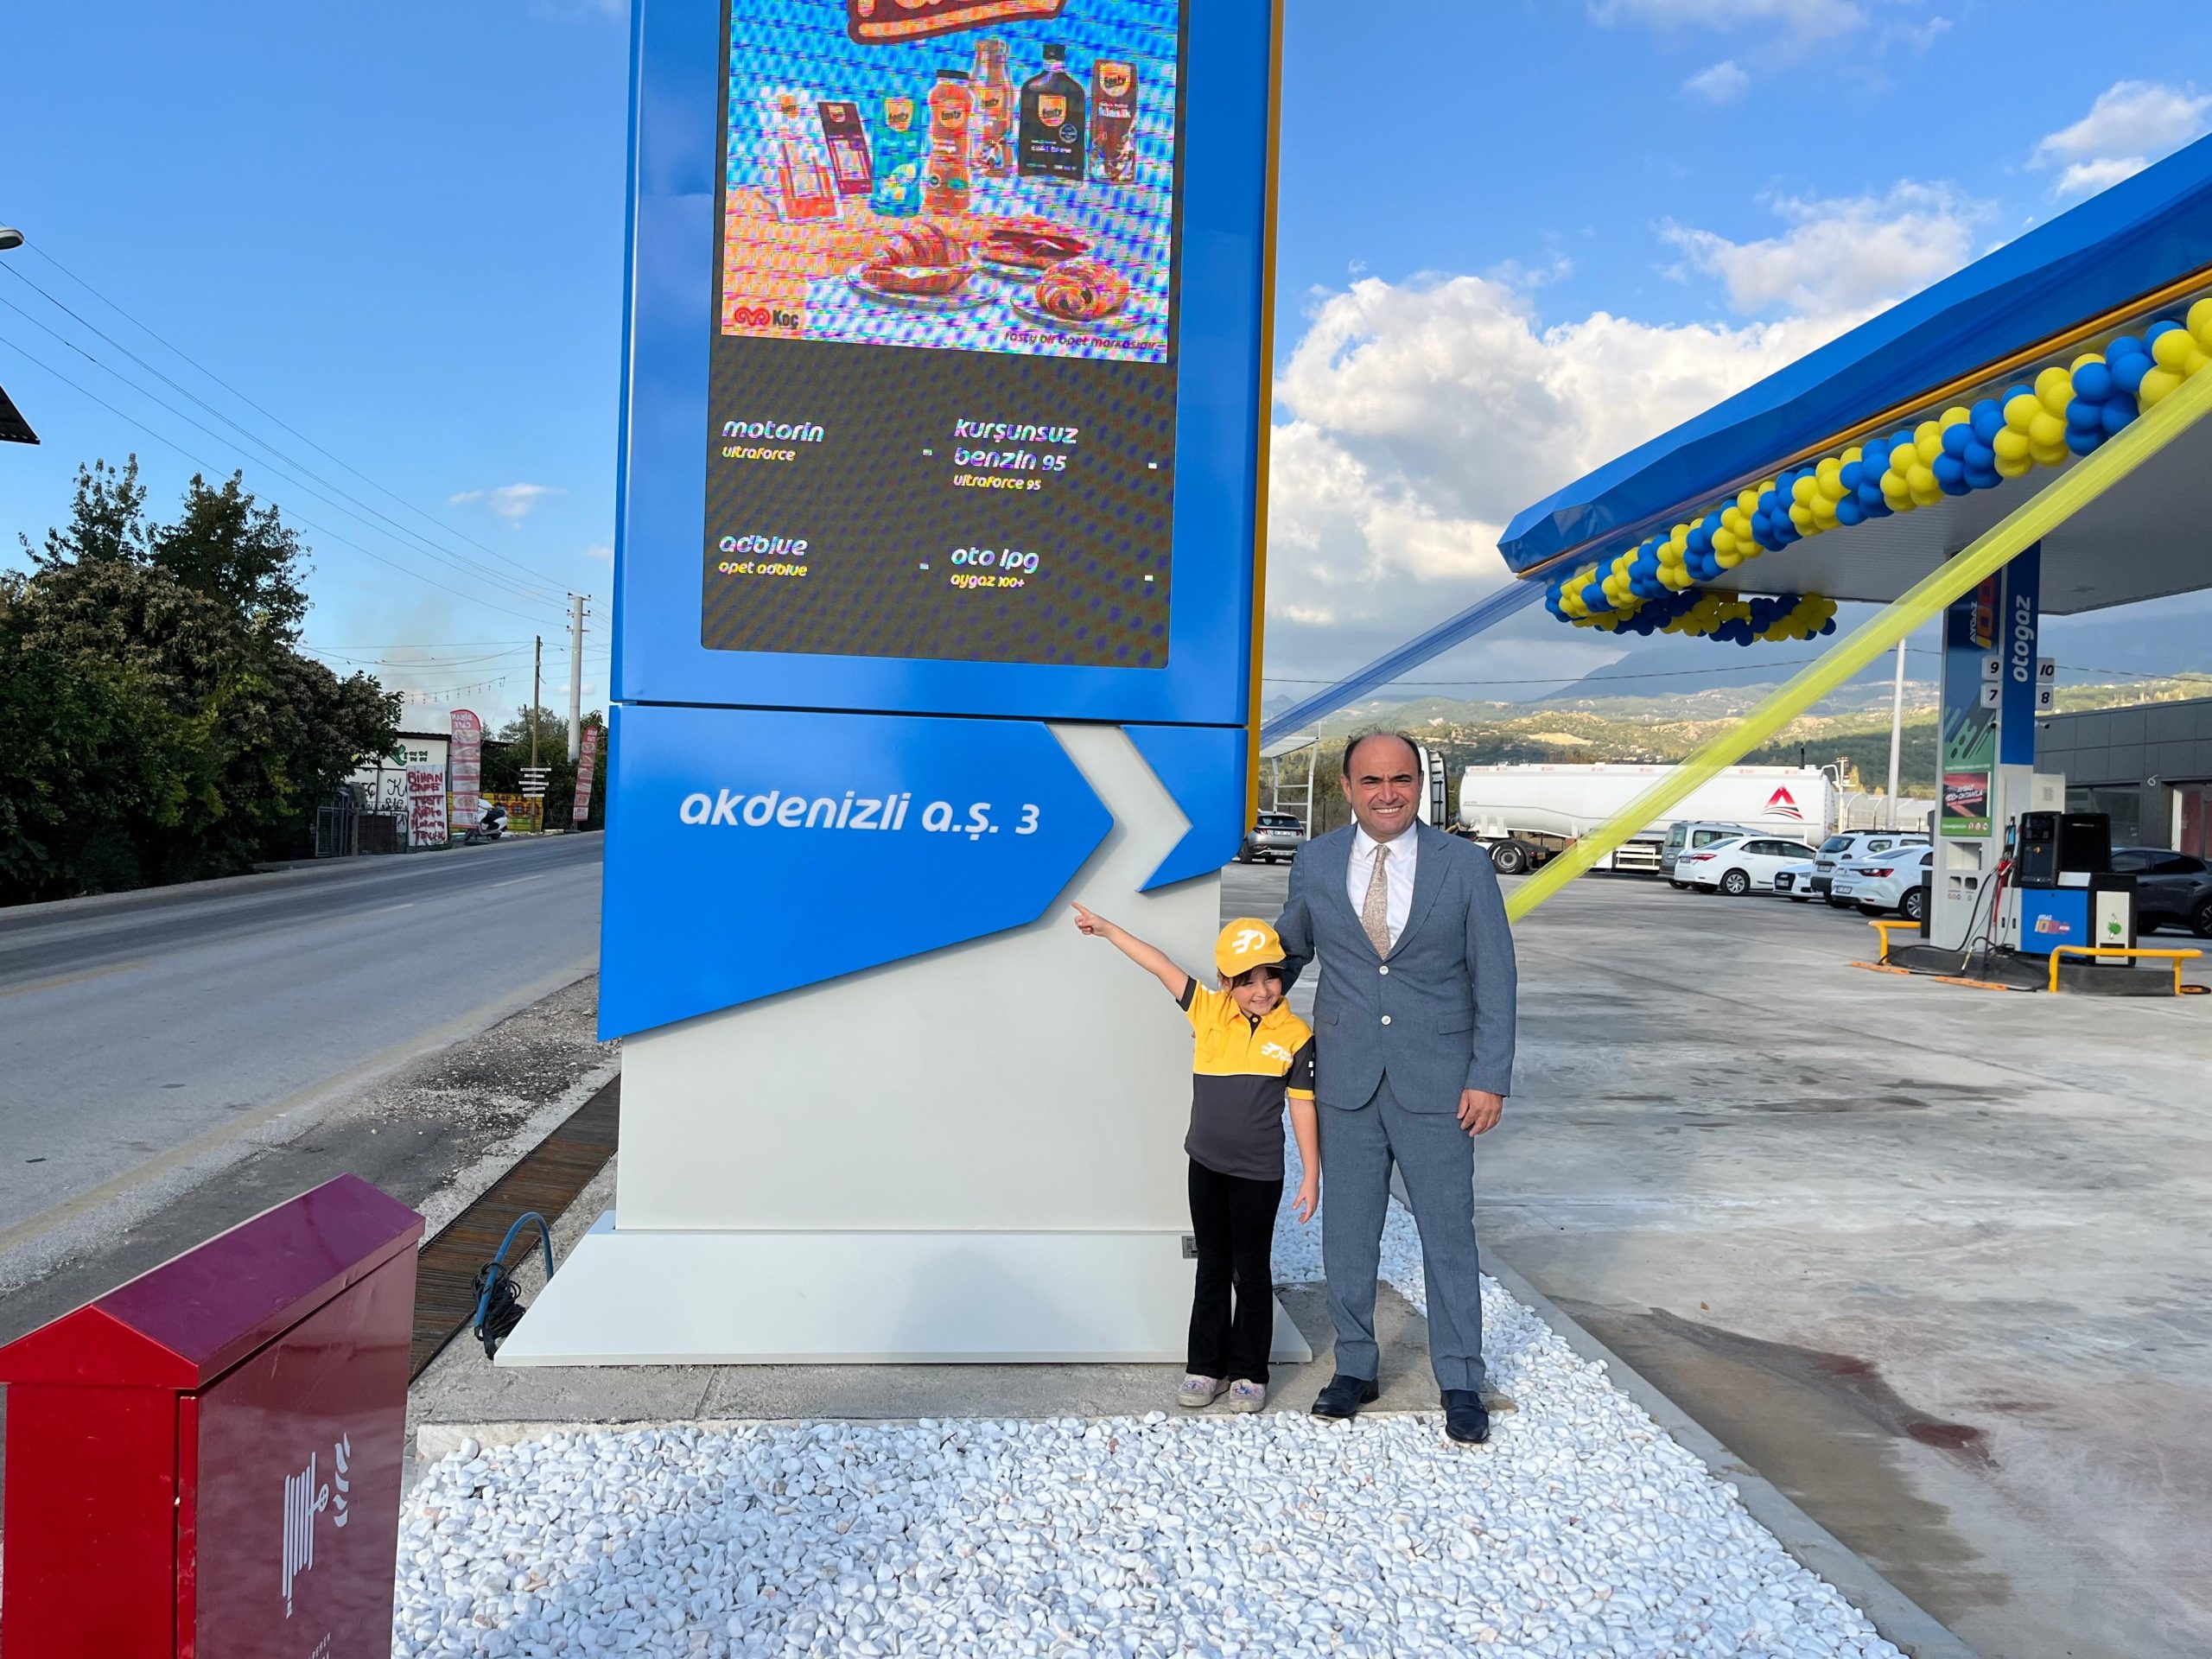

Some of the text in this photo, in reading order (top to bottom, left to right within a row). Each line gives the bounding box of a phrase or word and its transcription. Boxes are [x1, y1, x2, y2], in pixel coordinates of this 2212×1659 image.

[773, 309, 798, 329] Koç
[721, 420, 825, 442] motorin
[954, 418, 1079, 444] kurşunsuz
[722, 445, 797, 461] ultraforce
[954, 447, 1067, 472] benzin 95
[953, 474, 1042, 491] ultraforce 95
[719, 534, 809, 556] adblue
[718, 561, 808, 577] opet adblue
[950, 547, 1039, 575] oto lpg
[950, 574, 1026, 589] aygaz 100+
[1969, 601, 1978, 643] AYGAZ
[2012, 594, 2035, 683] otogaz
[1990, 662, 1999, 674] 9
[2040, 664, 2055, 677] 10
[1989, 690, 1999, 701] 7
[2041, 692, 2050, 704] 8
[679, 788, 1041, 841] akdenizli a.ş. 3
